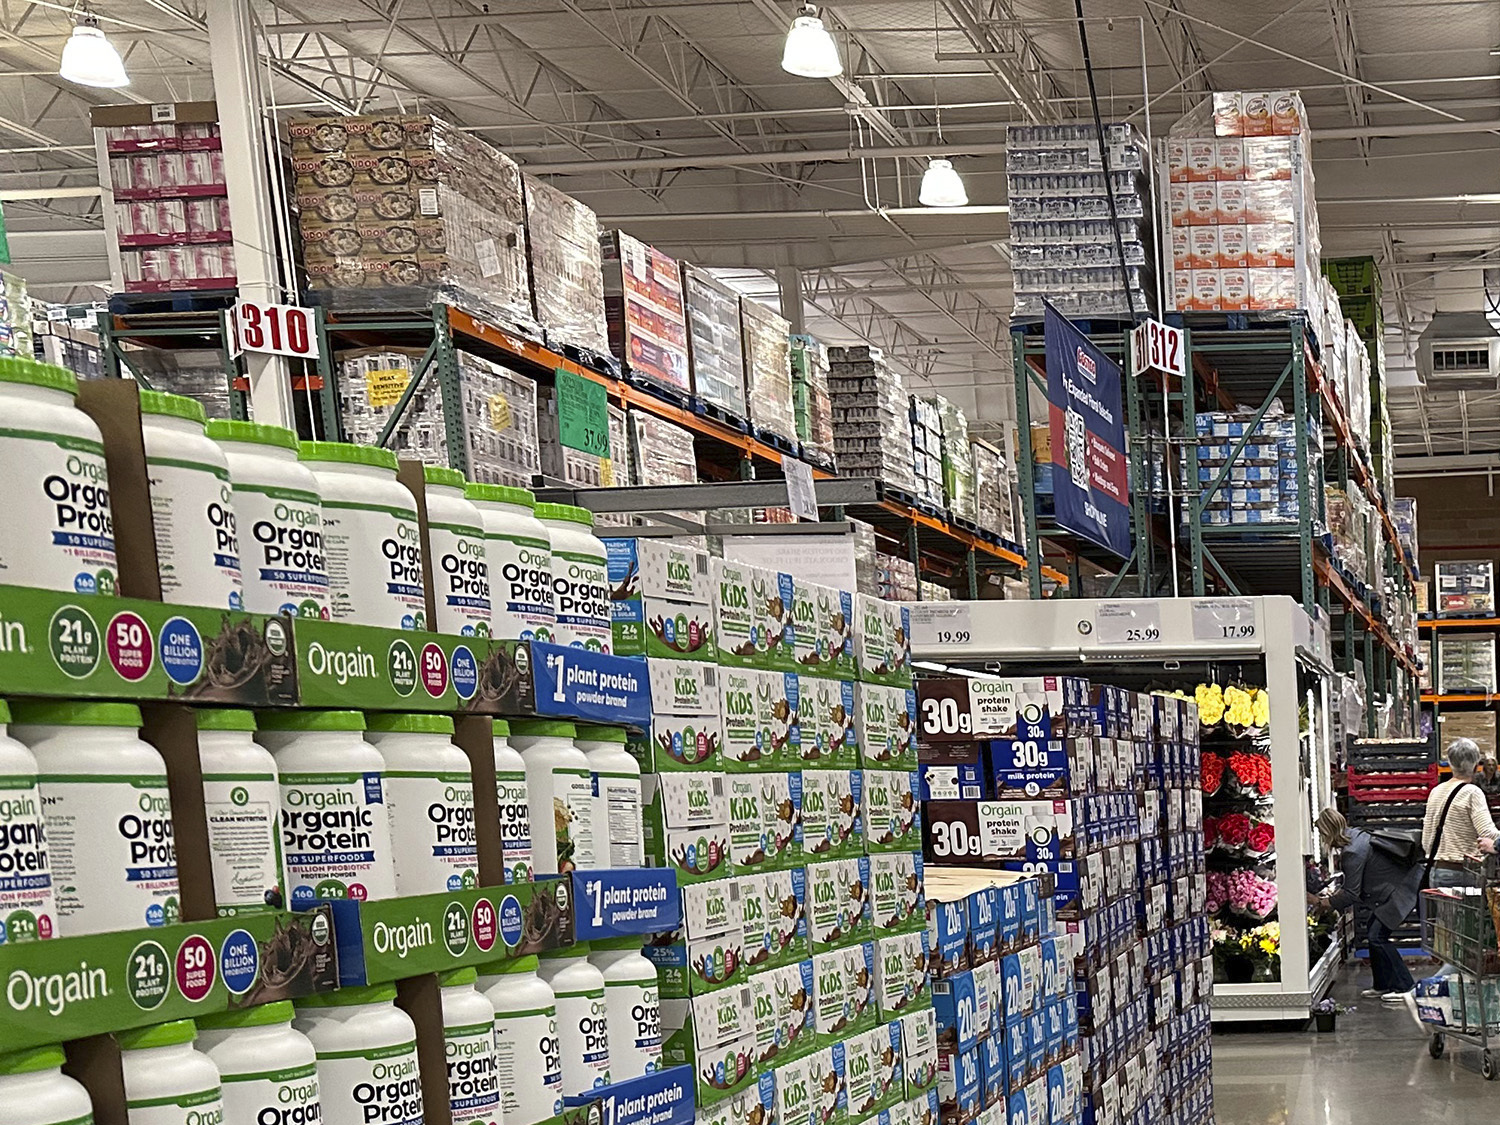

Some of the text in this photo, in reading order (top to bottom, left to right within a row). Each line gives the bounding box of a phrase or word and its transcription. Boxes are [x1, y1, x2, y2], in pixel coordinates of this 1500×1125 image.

[242, 303, 309, 353] 310
[1150, 324, 1179, 371] 312
[584, 428, 608, 452] 37.99
[722, 566, 742, 581] Orgain
[58, 618, 92, 644] 21g
[116, 622, 142, 647] 50
[622, 625, 637, 634] 24
[1126, 629, 1160, 641] 25.99
[1222, 626, 1255, 638] 17.99
[169, 633, 191, 645] ONE
[937, 631, 970, 643] 19.99
[62, 646, 89, 655] PLANT
[119, 650, 144, 658] SUPER
[164, 645, 198, 658] BILLION
[60, 654, 94, 664] PROTEIN
[308, 642, 376, 684] Orgain
[547, 653, 638, 702] #1 plant protein
[972, 682, 1013, 694] Orgain
[576, 691, 627, 708] powder brand
[978, 697, 1010, 706] protein
[981, 704, 1008, 713] shake
[922, 699, 972, 735] 30g
[1012, 741, 1048, 768] 30g
[1008, 772, 1054, 781] milk protein
[287, 789, 353, 810] Orgain
[981, 804, 1023, 817] Orgain
[987, 819, 1020, 829] protein
[991, 828, 1017, 836] shake
[931, 822, 981, 857] 30g
[302, 853, 366, 862] SUPERFOODS
[586, 880, 666, 927] #1 plant protein
[611, 906, 657, 924] powder brand
[373, 919, 433, 958] Orgain
[7, 961, 108, 1016] Orgain
